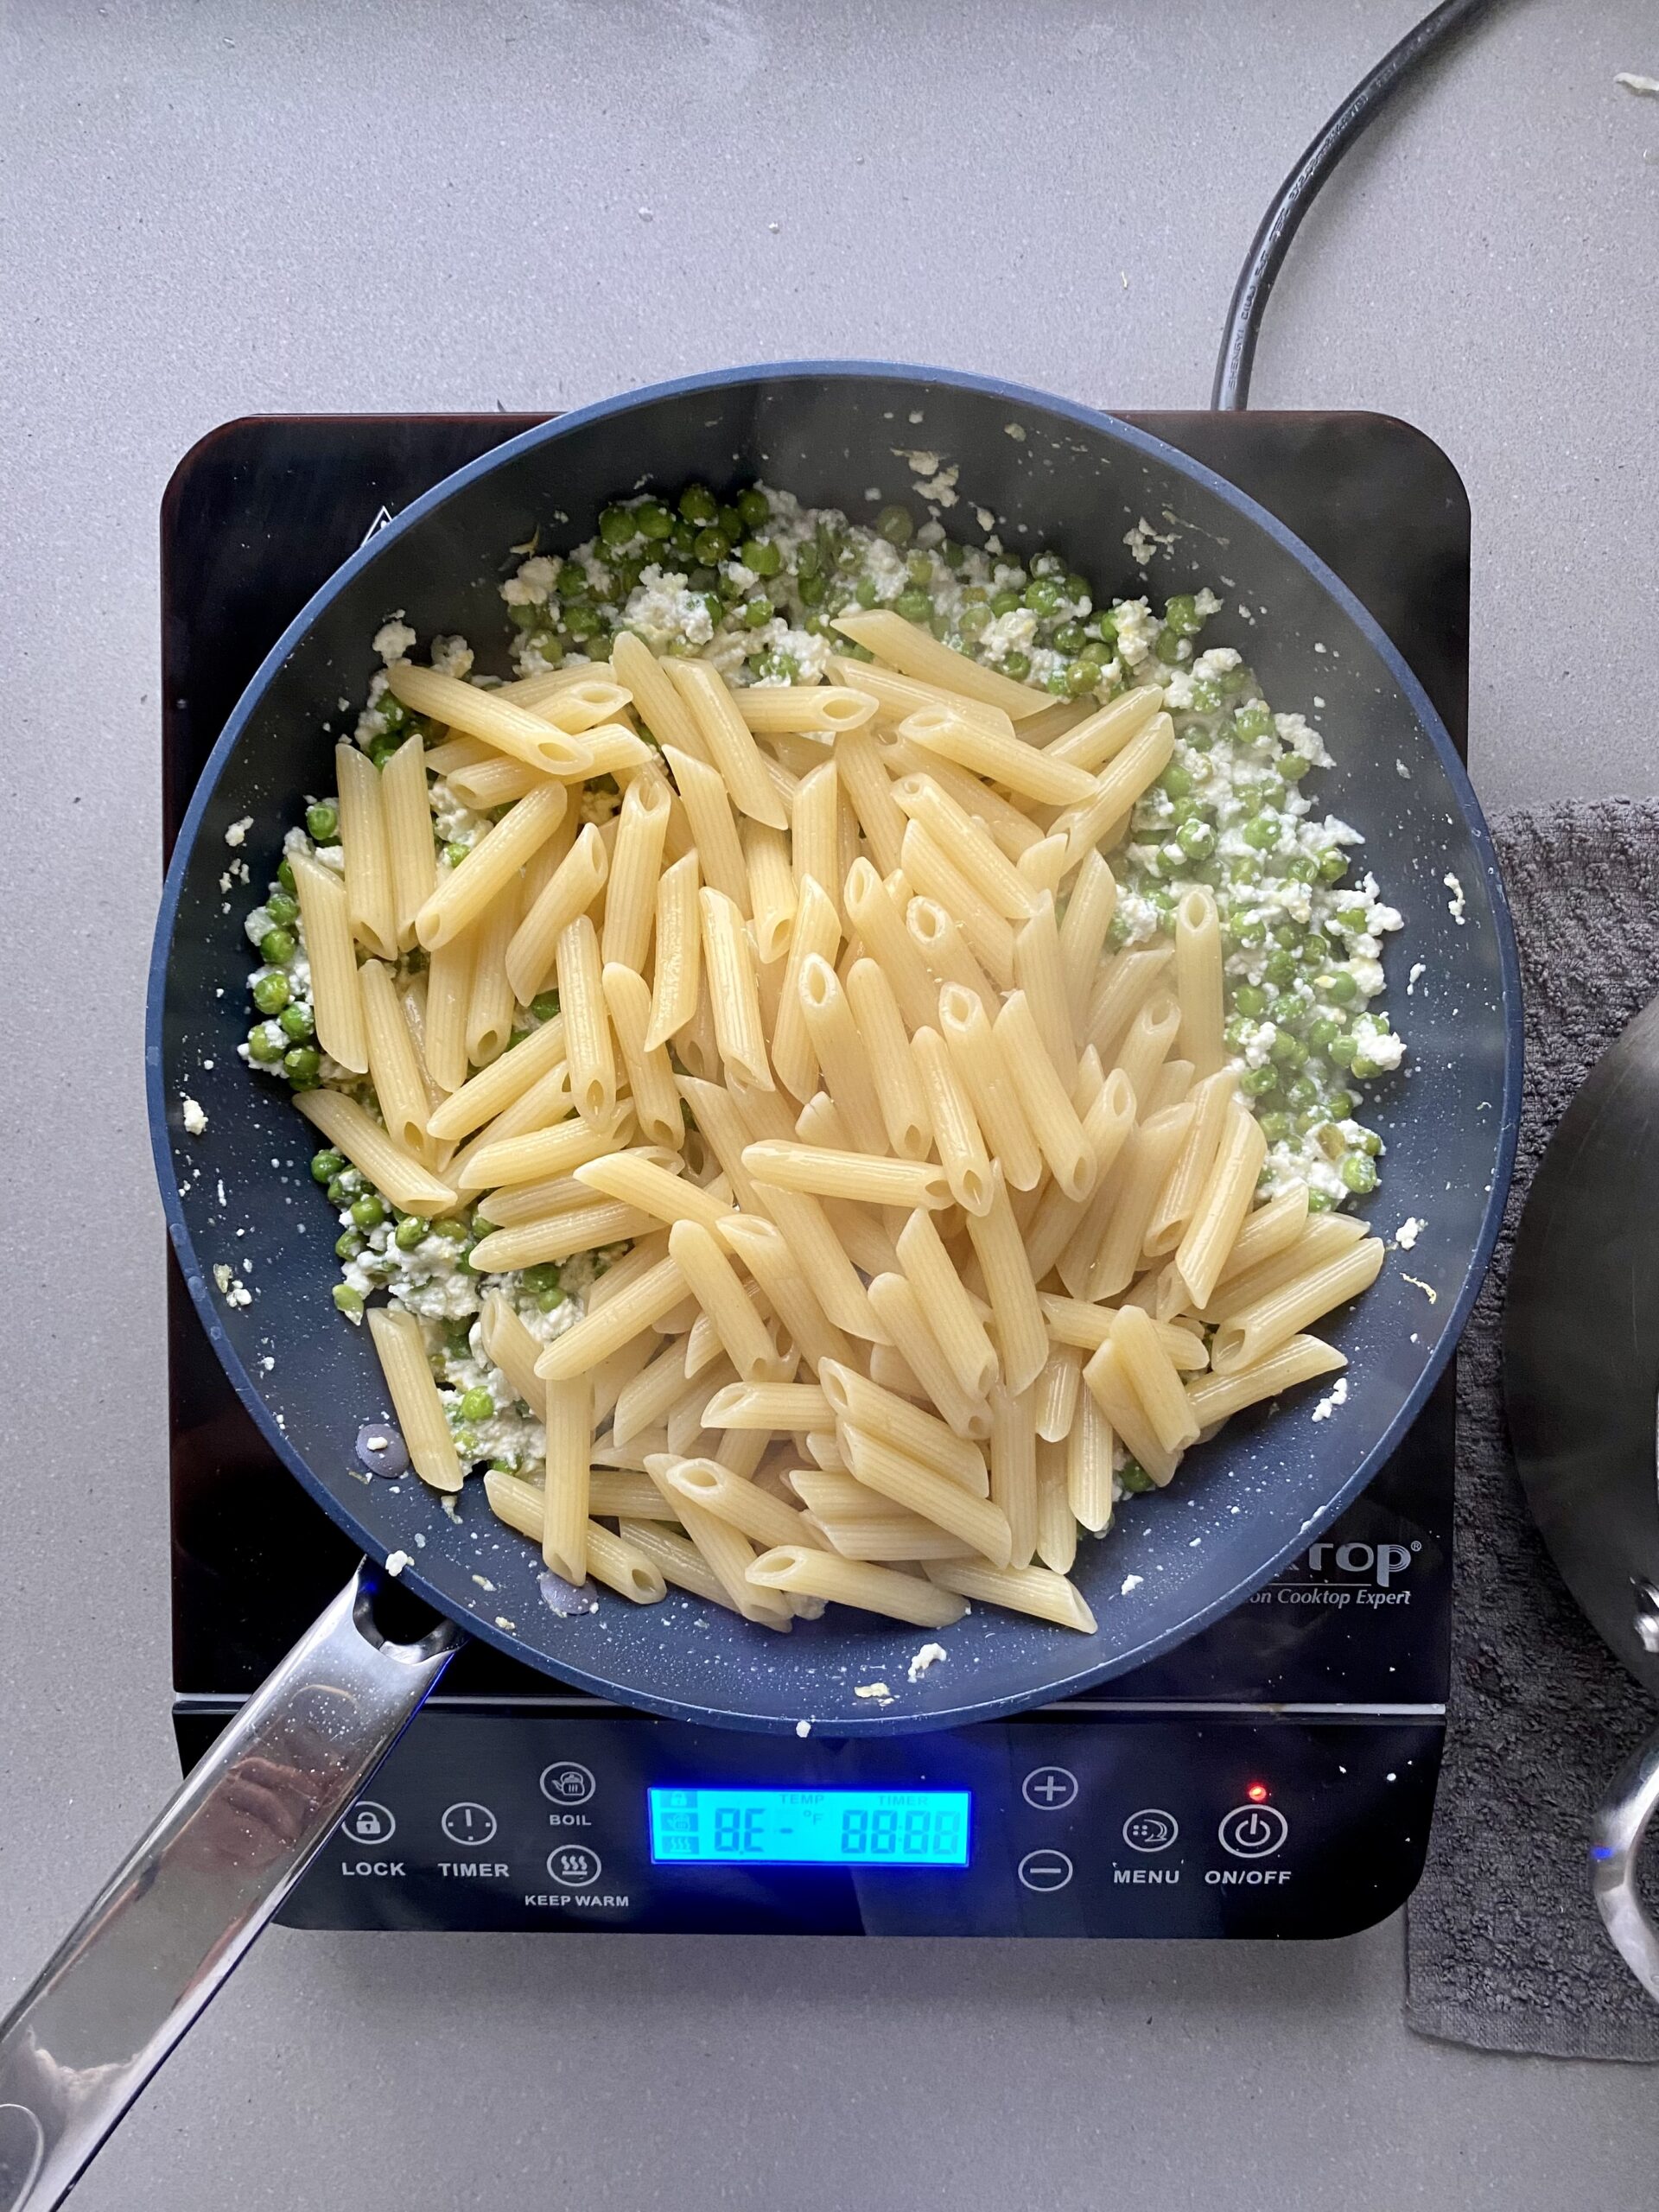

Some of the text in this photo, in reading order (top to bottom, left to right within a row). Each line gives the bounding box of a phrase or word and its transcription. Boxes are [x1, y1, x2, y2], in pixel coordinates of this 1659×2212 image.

[1248, 1587, 1412, 1610] on Cooktop Expert
[779, 1794, 825, 1806] TEMP
[878, 1796, 929, 1806] TIMER
[549, 1814, 593, 1827] BOIL
[341, 1861, 407, 1878] LOCK
[437, 1862, 511, 1878] TIMER
[1113, 1869, 1180, 1885] MENU
[1204, 1870, 1292, 1885] ON/OFF
[524, 1894, 630, 1908] KEEP WARM
